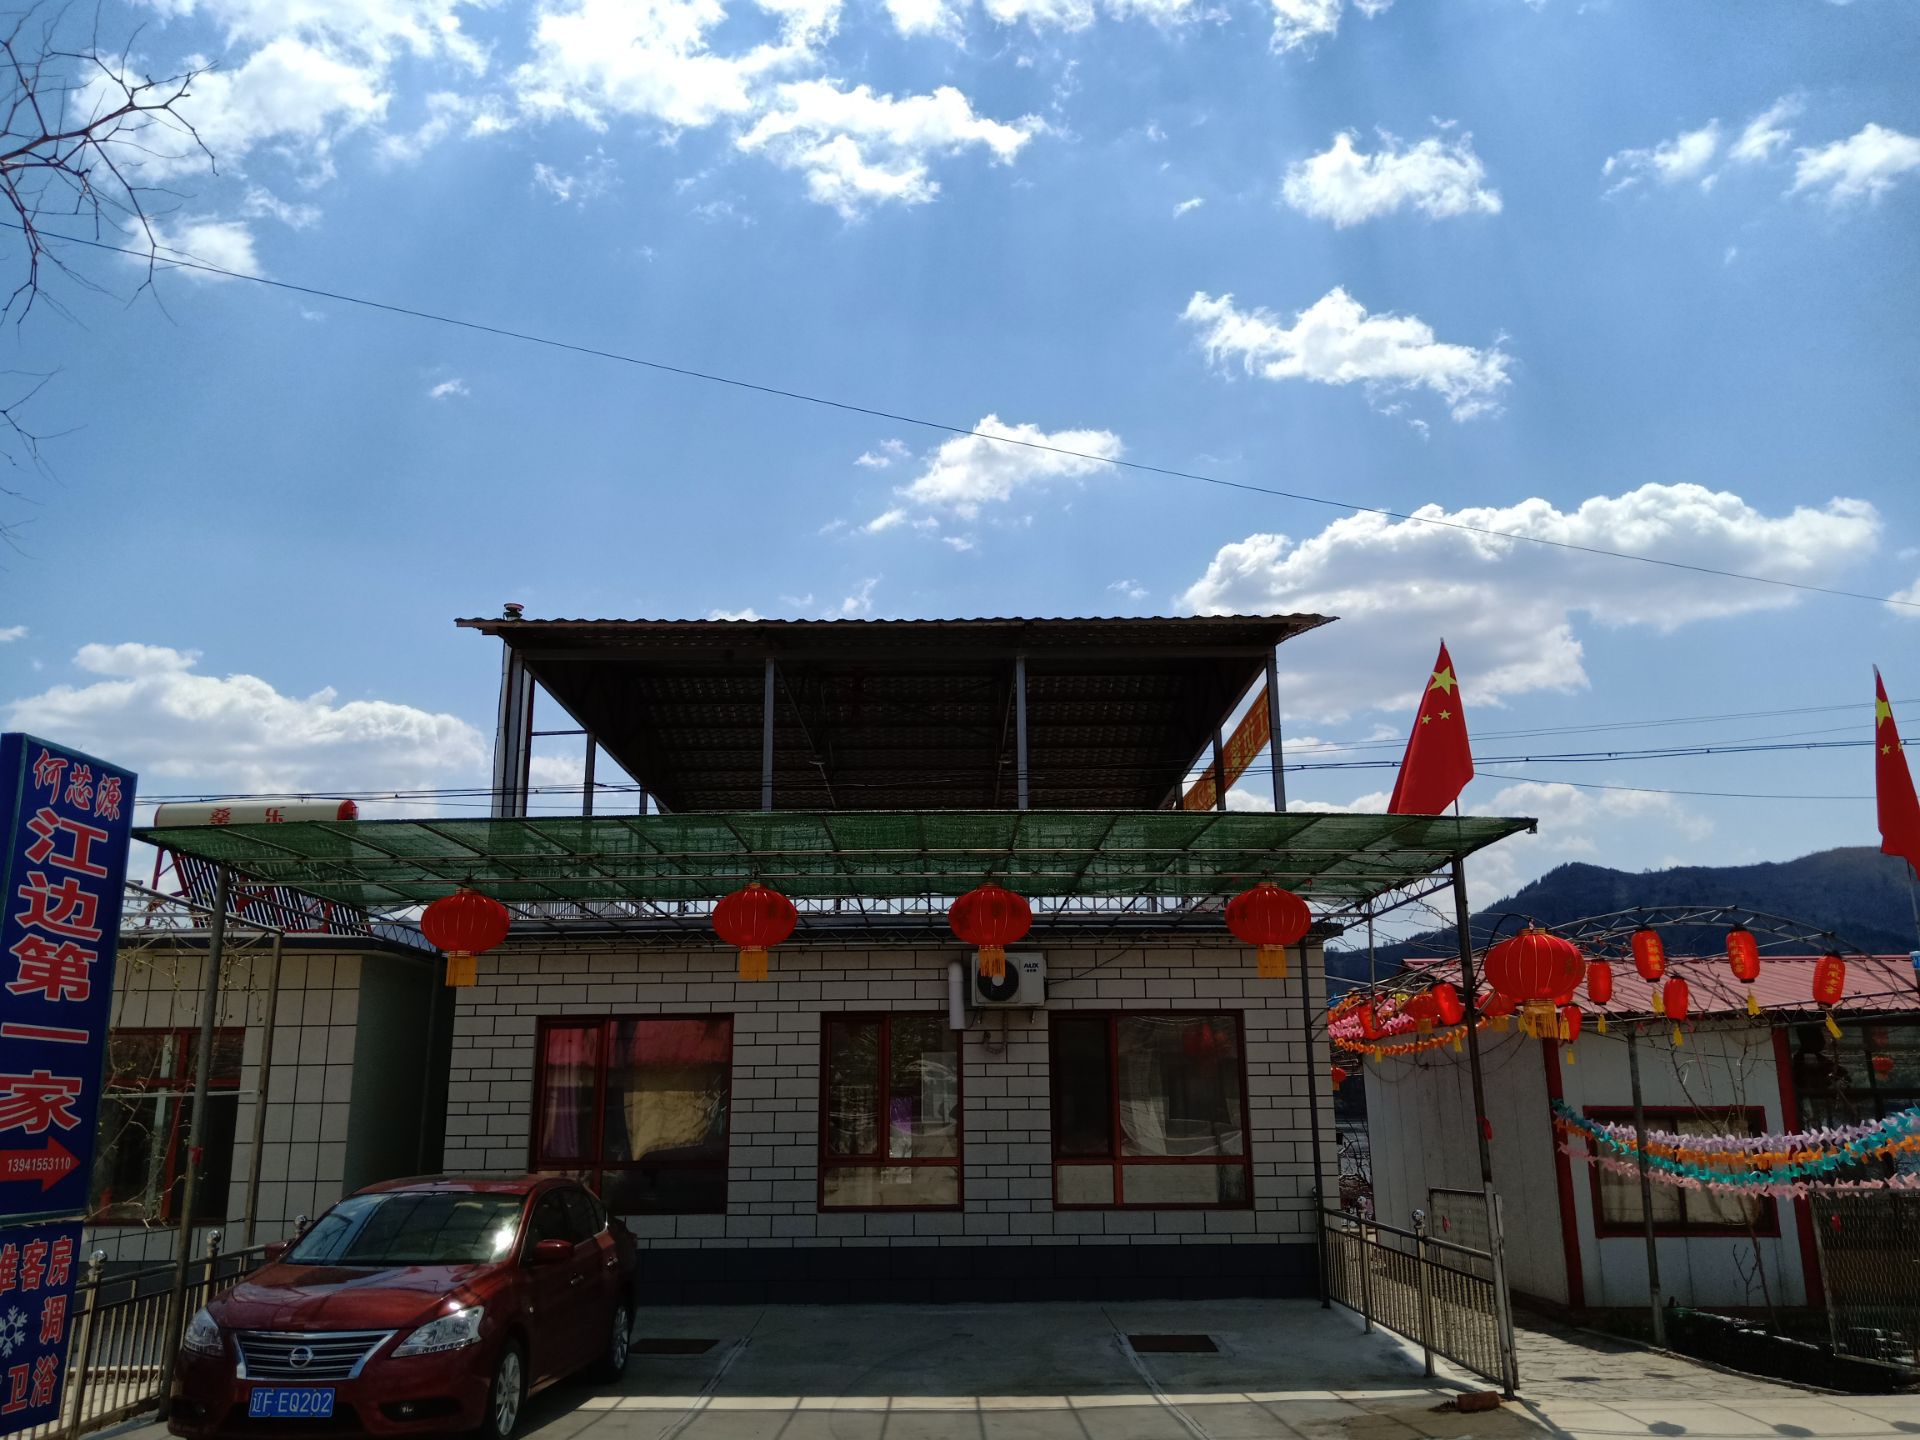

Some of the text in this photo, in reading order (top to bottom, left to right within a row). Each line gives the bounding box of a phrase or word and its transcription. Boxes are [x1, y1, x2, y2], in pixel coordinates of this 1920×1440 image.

[0, 807, 108, 1134] 江边第一家
[8, 1157, 71, 1172] 13941553110
[1, 1353, 59, 1415] 卫浴
